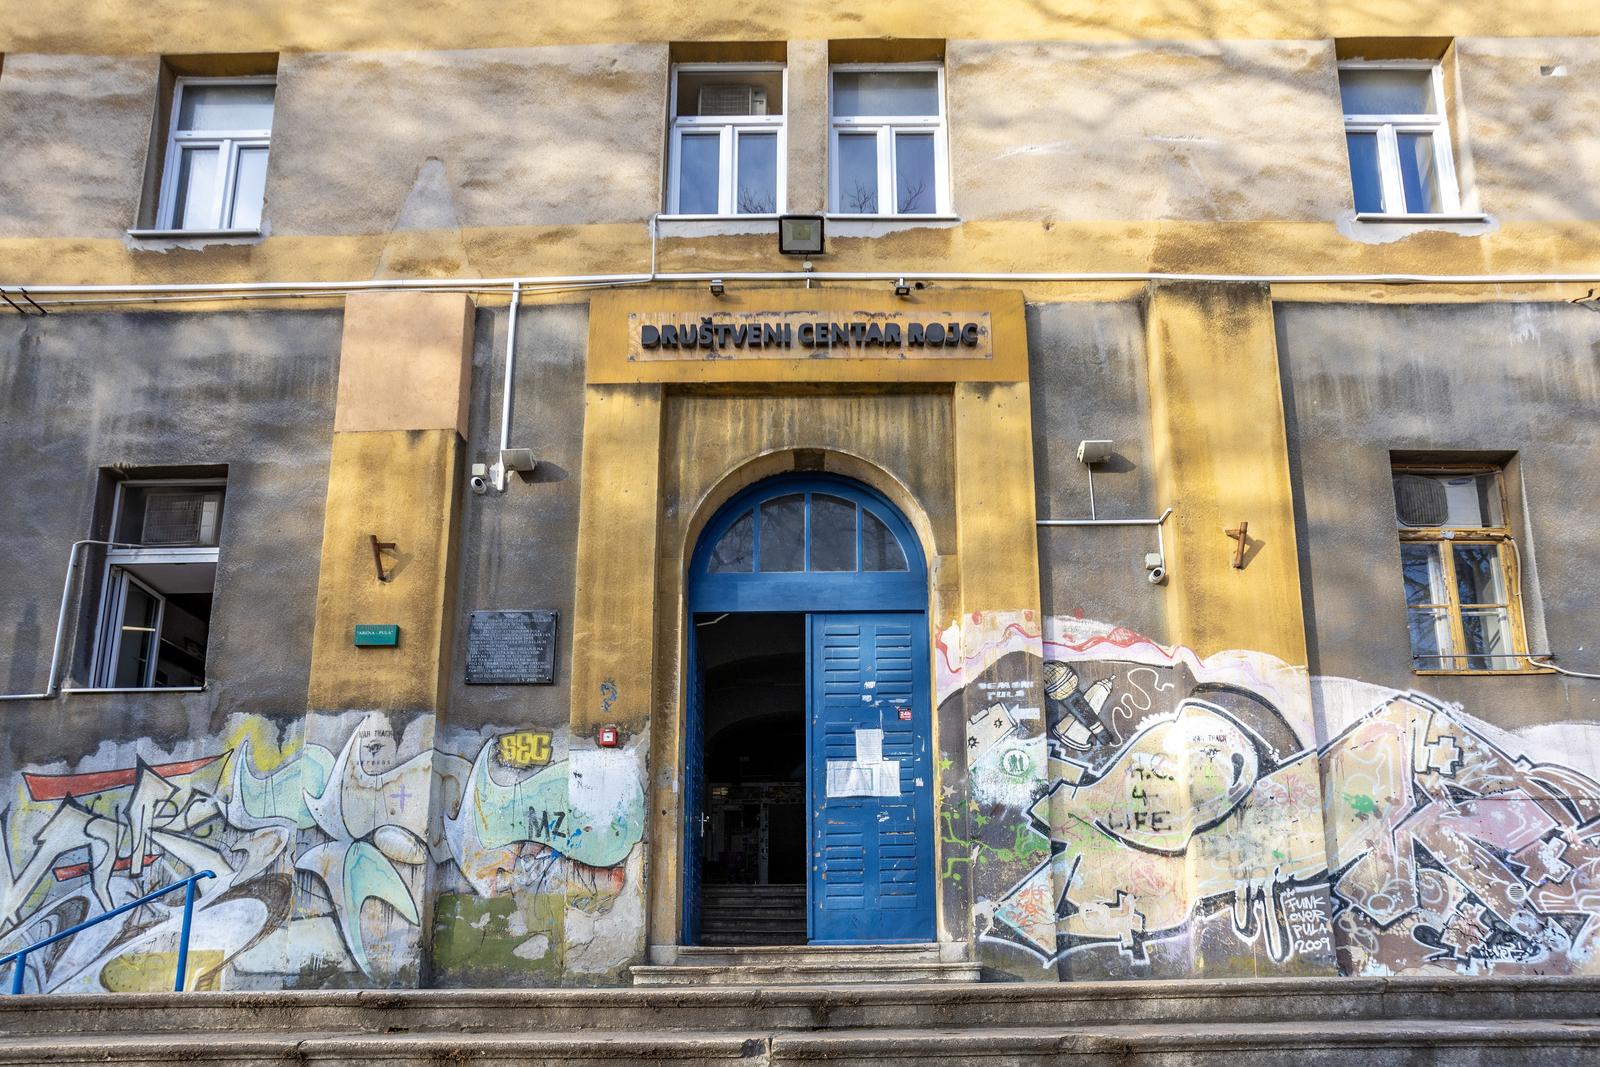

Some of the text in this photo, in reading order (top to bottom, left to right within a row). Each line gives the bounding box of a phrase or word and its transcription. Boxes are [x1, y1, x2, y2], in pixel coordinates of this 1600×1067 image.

[641, 317, 979, 349] DRUŠTVENI CENTAR ROJC
[500, 731, 551, 766] SEC
[1108, 811, 1171, 832] LIFE
[1284, 895, 1326, 912] FUNK
[1291, 922, 1327, 939] PULA
[1294, 936, 1331, 953] 2009
